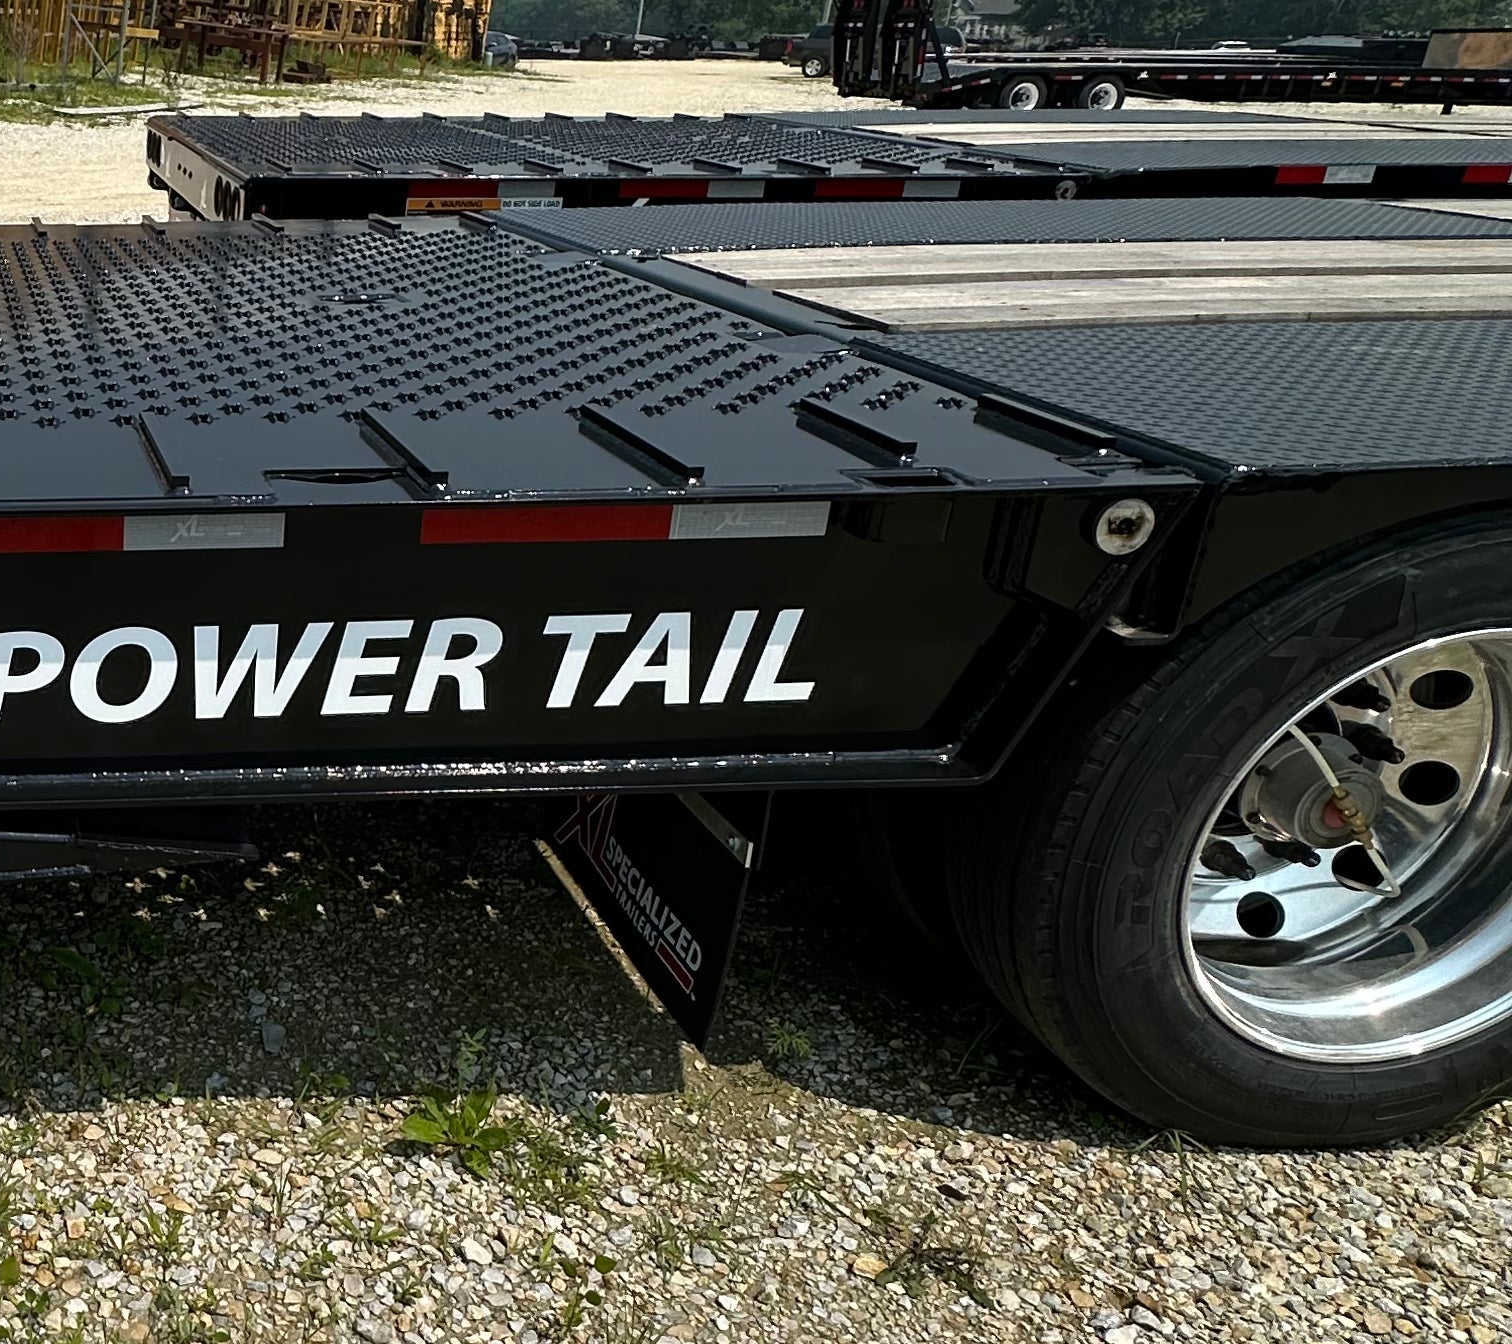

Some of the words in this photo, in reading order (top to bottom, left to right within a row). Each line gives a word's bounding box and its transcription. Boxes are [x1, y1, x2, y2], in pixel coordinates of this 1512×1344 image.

[440, 200, 483, 208] WARNING
[543, 608, 816, 707] TAIL
[606, 836, 702, 971] SPECIALIZED
[614, 883, 657, 947] TRAILERS
